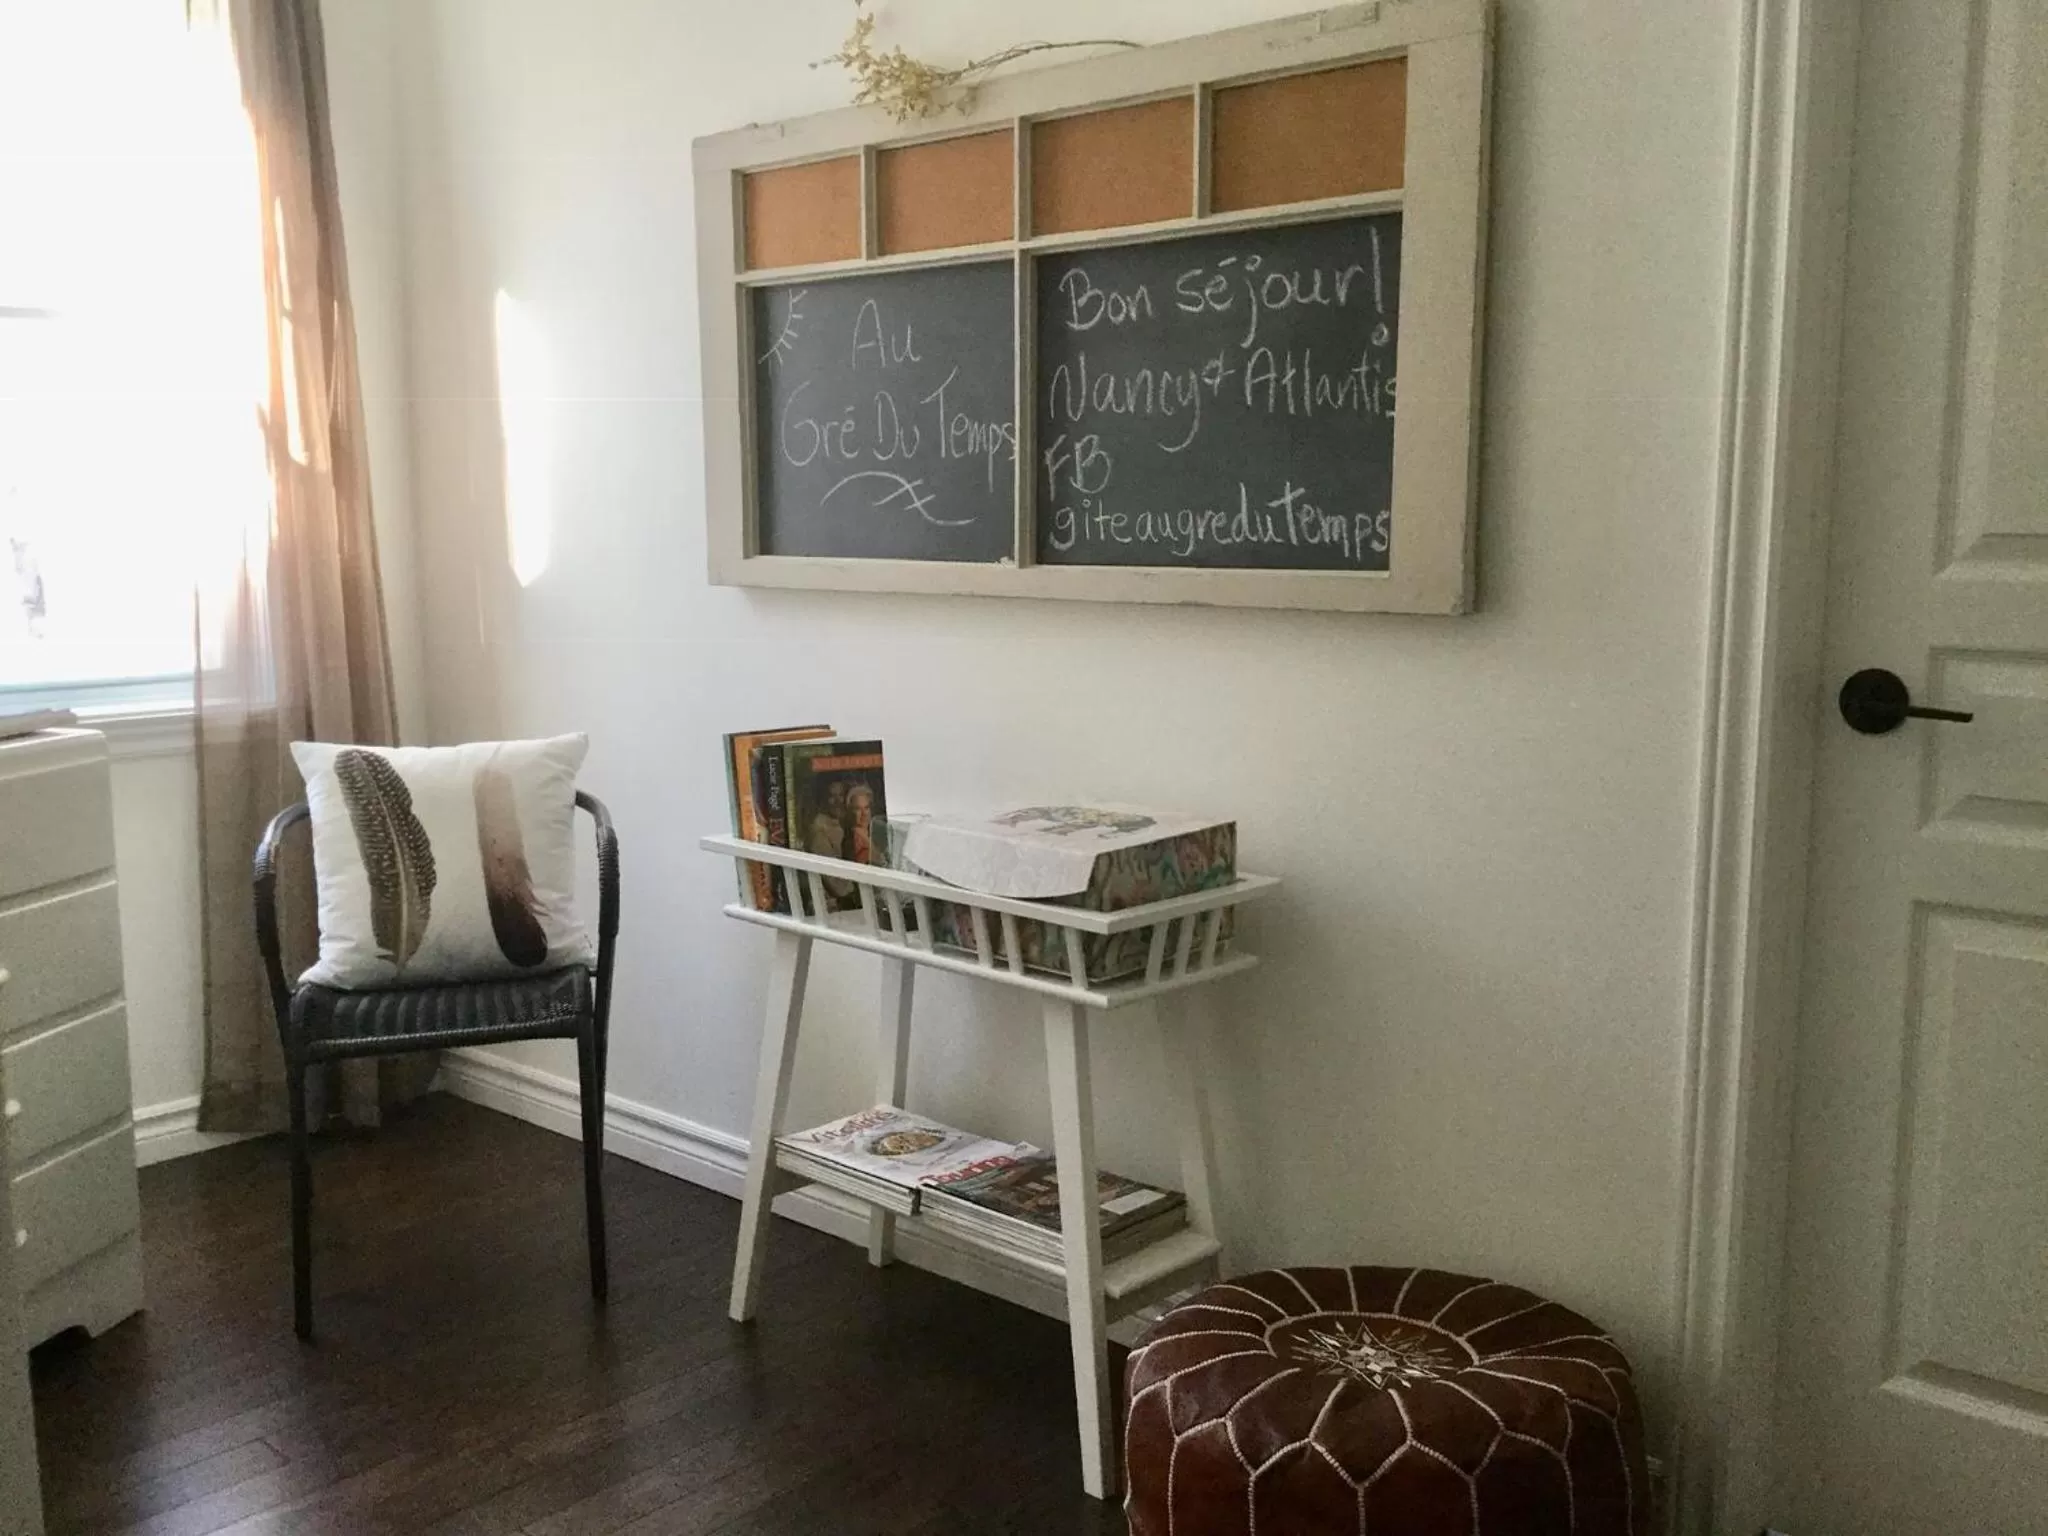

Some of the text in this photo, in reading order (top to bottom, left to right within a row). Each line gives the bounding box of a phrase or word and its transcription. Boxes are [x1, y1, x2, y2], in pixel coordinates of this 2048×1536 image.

[1059, 267, 1152, 330] Bon
[852, 299, 920, 371] Au
[781, 380, 859, 467] Gré
[872, 390, 921, 461] Du
[1050, 351, 1200, 453] Nancy
[1245, 347, 1397, 418] Atlantis
[1045, 434, 1112, 501] FB
